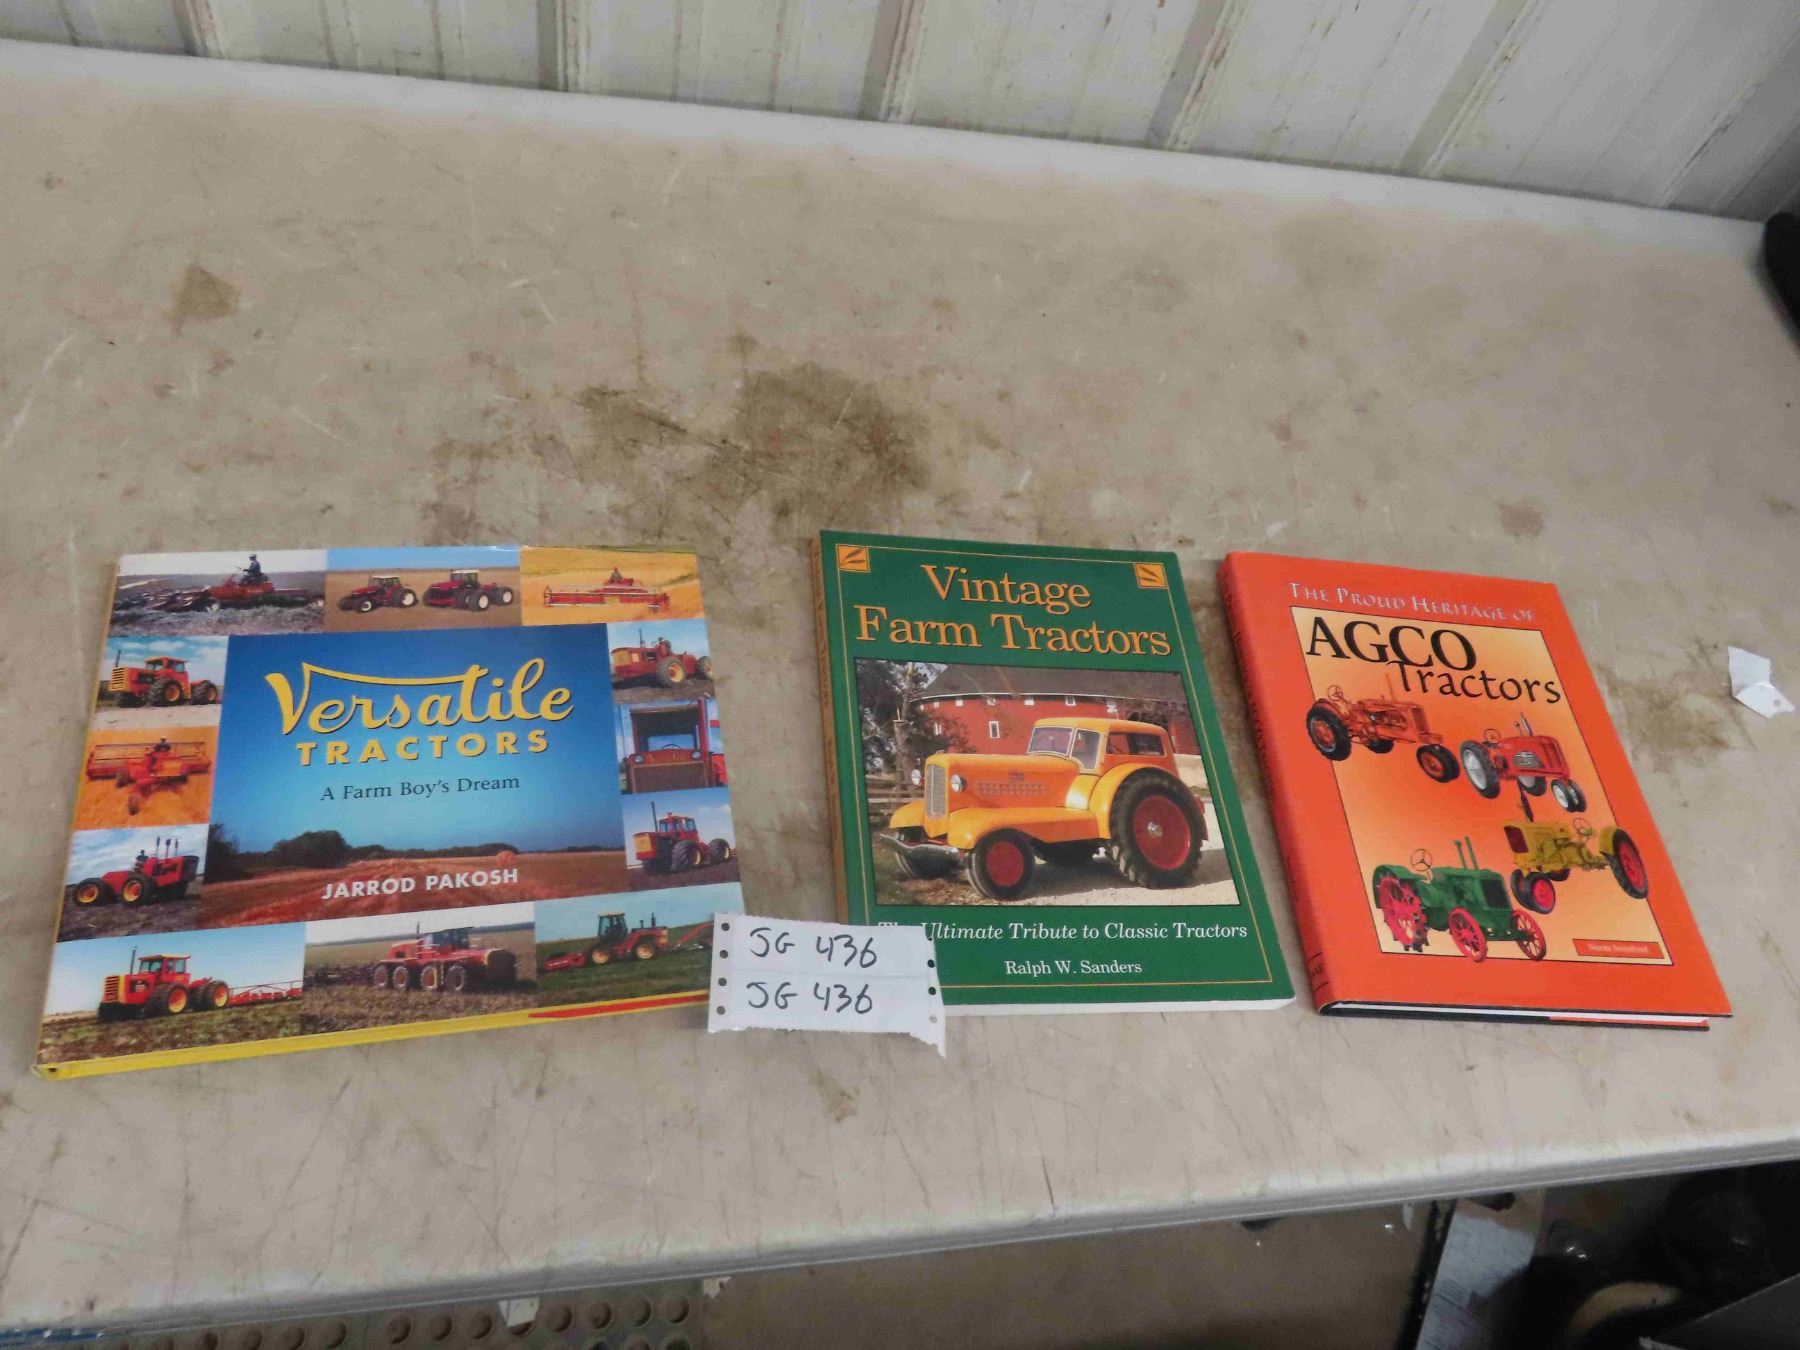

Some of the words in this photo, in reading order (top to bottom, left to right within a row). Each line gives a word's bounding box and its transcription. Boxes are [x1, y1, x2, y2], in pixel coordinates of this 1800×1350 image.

[921, 564, 1091, 615] Vintage
[853, 605, 983, 648] Farm
[990, 613, 1172, 656] Tractors
[1305, 616, 1477, 672] AGCO
[264, 658, 575, 735] Versatile
[1386, 659, 1563, 704] Tractors
[296, 729, 549, 766] TRACTORS
[320, 787, 335, 801] A
[343, 784, 392, 800] Farm
[400, 779, 450, 798] Boy's
[457, 776, 520, 793] Dream
[321, 877, 416, 900] JARROD
[425, 868, 518, 891] PAKOSH
[921, 923, 1003, 940] Ultimate
[1009, 922, 1076, 940] Tribute
[1082, 923, 1099, 940] to
[1104, 922, 1169, 940] Classic
[1173, 922, 1248, 939] Tractors
[816, 934, 878, 969] 436
[1004, 960, 1051, 978] Ralph
[1054, 960, 1077, 975] W.
[1080, 959, 1142, 975] Sanders
[813, 982, 873, 1014] 436
